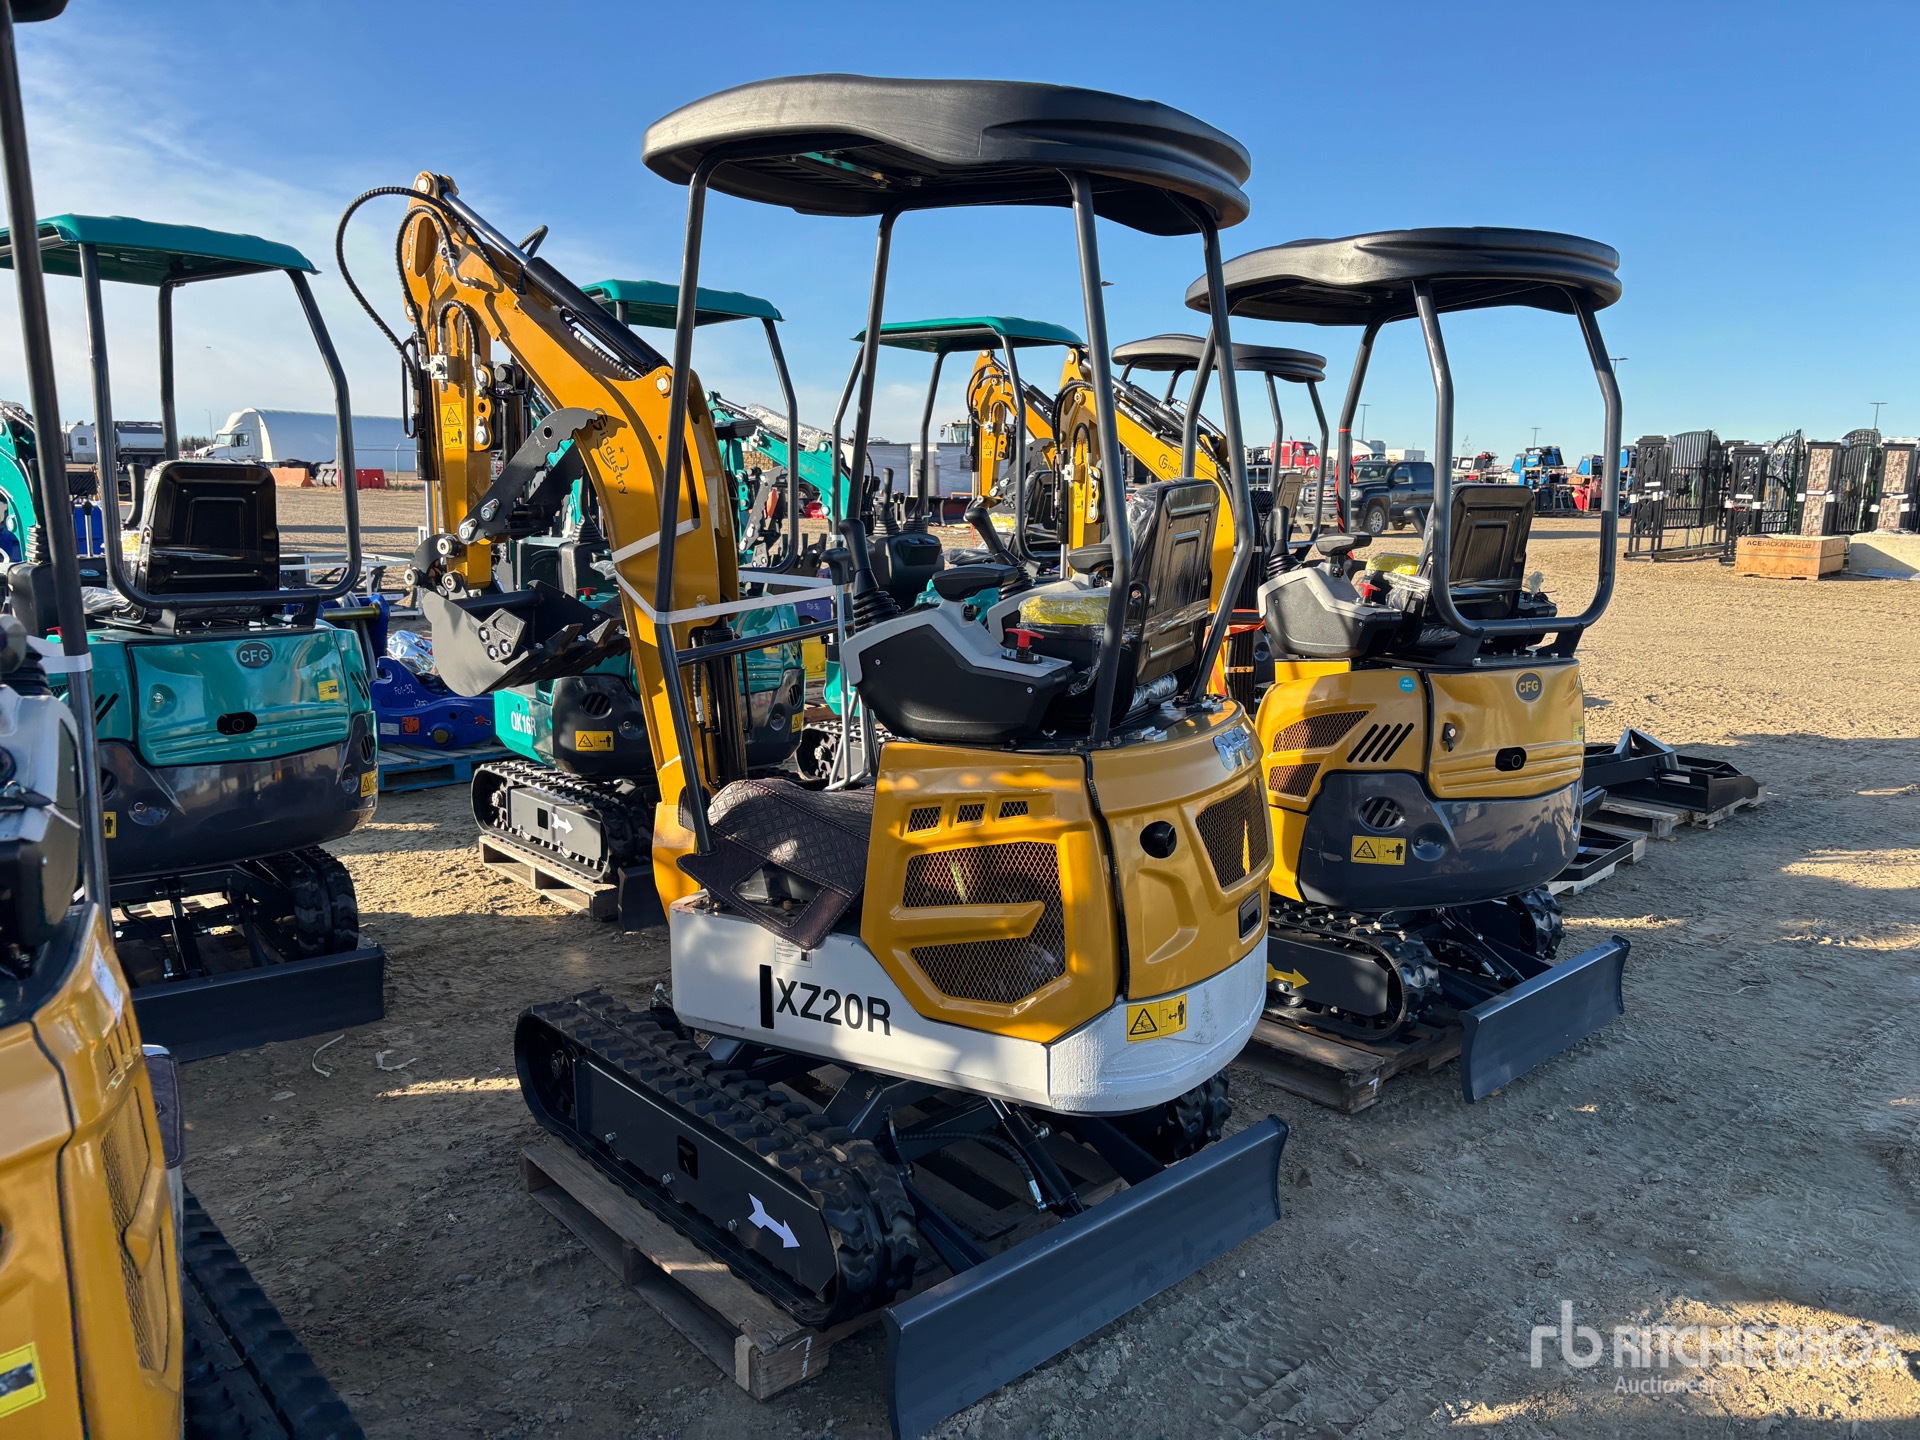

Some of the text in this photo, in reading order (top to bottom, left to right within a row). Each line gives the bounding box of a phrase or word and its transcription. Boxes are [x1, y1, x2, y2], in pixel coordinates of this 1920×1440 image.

[239, 649, 269, 663] CFG
[1518, 680, 1539, 693] CFG
[776, 977, 891, 1036] XZ20R
